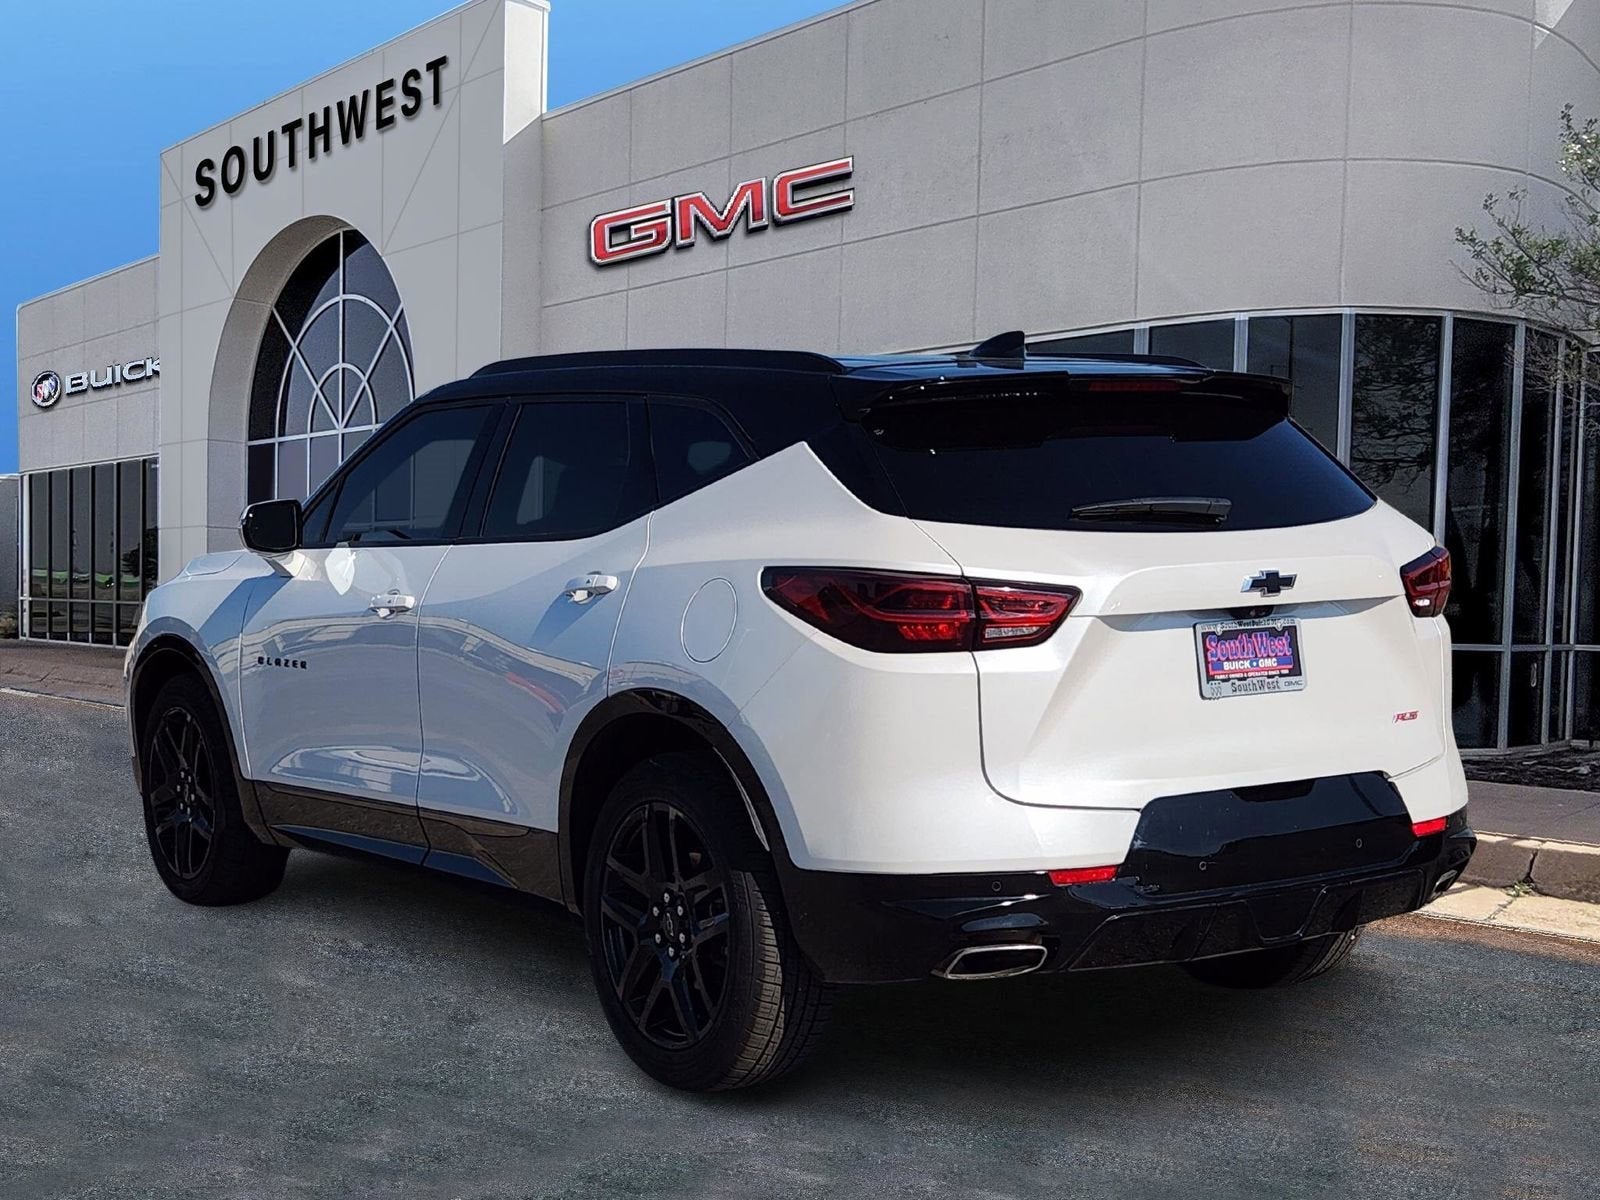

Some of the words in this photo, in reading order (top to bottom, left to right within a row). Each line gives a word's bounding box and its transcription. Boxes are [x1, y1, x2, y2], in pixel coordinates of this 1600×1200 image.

[194, 55, 448, 208] SOUTHWEST
[589, 155, 855, 264] GMC
[64, 357, 160, 394] BUICK
[257, 656, 307, 670] BLAZER
[1223, 660, 1251, 671] BUICK
[1258, 658, 1278, 668] GMC
[1393, 710, 1419, 723] RS
